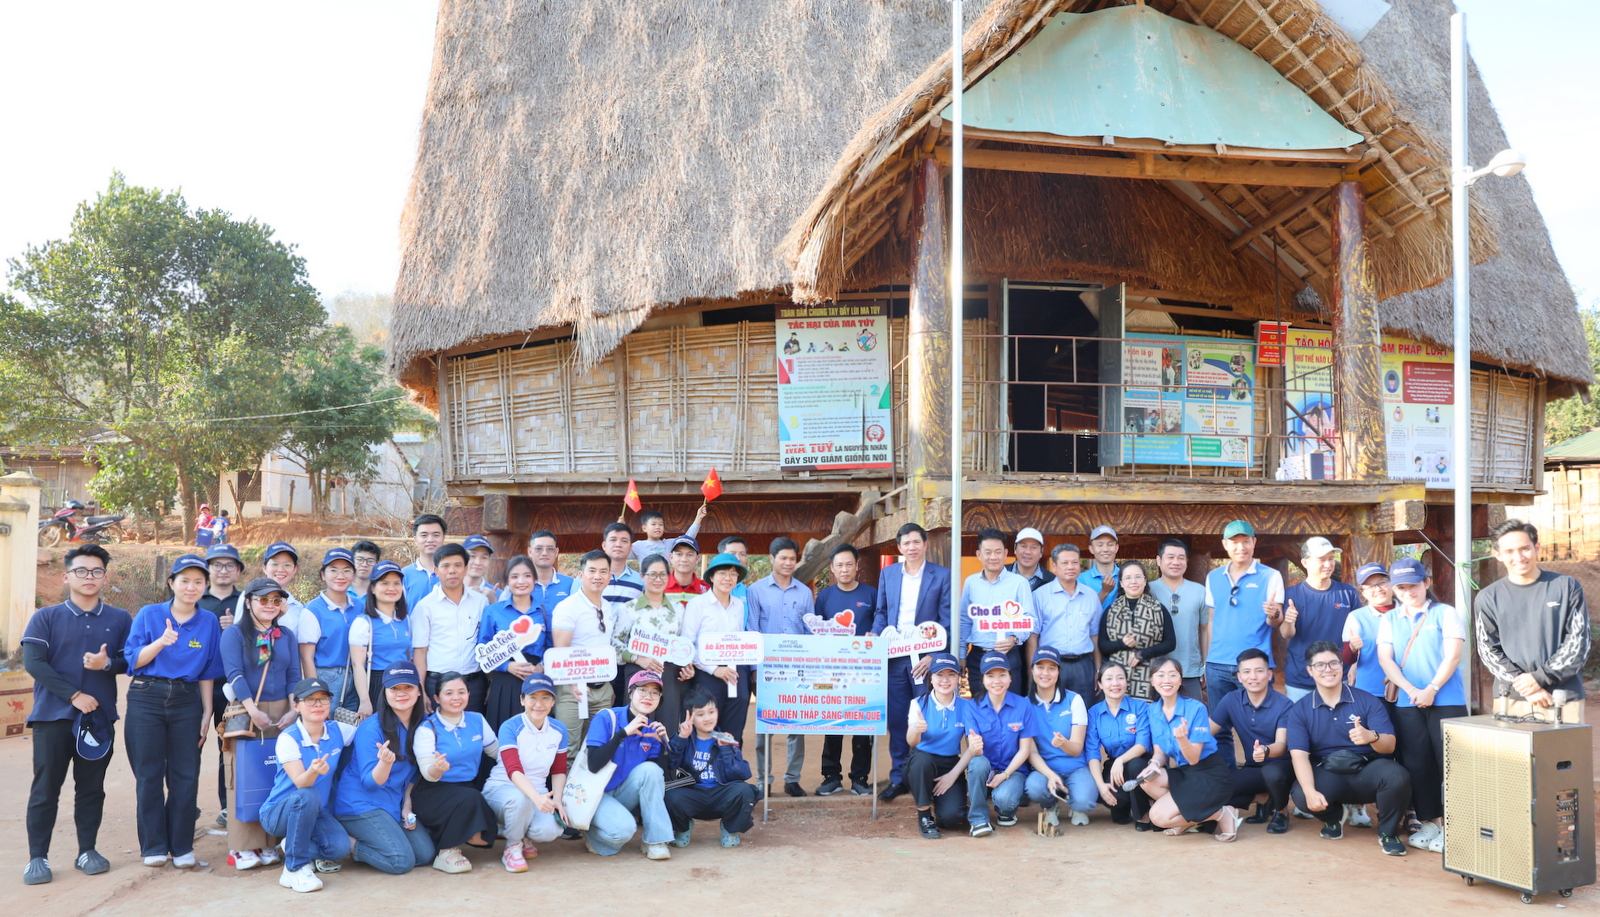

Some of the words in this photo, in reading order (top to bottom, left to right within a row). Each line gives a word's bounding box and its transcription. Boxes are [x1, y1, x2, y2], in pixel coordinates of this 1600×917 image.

[788, 321, 804, 329] TÁC
[806, 321, 820, 330] HẠI
[823, 319, 840, 328] CỦA
[858, 318, 875, 327] TÚY
[1295, 335, 1314, 348] TẢO
[1318, 337, 1332, 349] HÔ
[1381, 343, 1395, 356] ẠM
[1398, 342, 1422, 354] PHÁP
[785, 359, 793, 373] 1
[870, 384, 879, 395] 2
[790, 416, 798, 427] 3
[785, 444, 806, 454] MA
[971, 606, 989, 616] Cho
[992, 606, 1001, 616] đi
[980, 620, 989, 630] là
[992, 620, 1010, 629] còn
[1013, 618, 1031, 628] mãi
[634, 628, 650, 640] Mùa
[652, 634, 669, 646] đông
[632, 638, 649, 653] ẤM
[652, 644, 667, 657] ÁP
[914, 640, 943, 650] ĐỒNG
[483, 652, 510, 669] nhân
[563, 659, 574, 668] ẤM
[591, 658, 609, 666] ĐÔNG
[567, 667, 595, 676] 2025
[778, 695, 797, 704] TRAO
[800, 694, 818, 706] TẶNG
[821, 694, 842, 704] CÔNG
[844, 694, 866, 705] TRÌNH
[762, 708, 777, 719] ĐÈN
[780, 709, 797, 721] ĐIỆN
[822, 710, 842, 720] SÁNG
[866, 710, 881, 720] QUÊ
